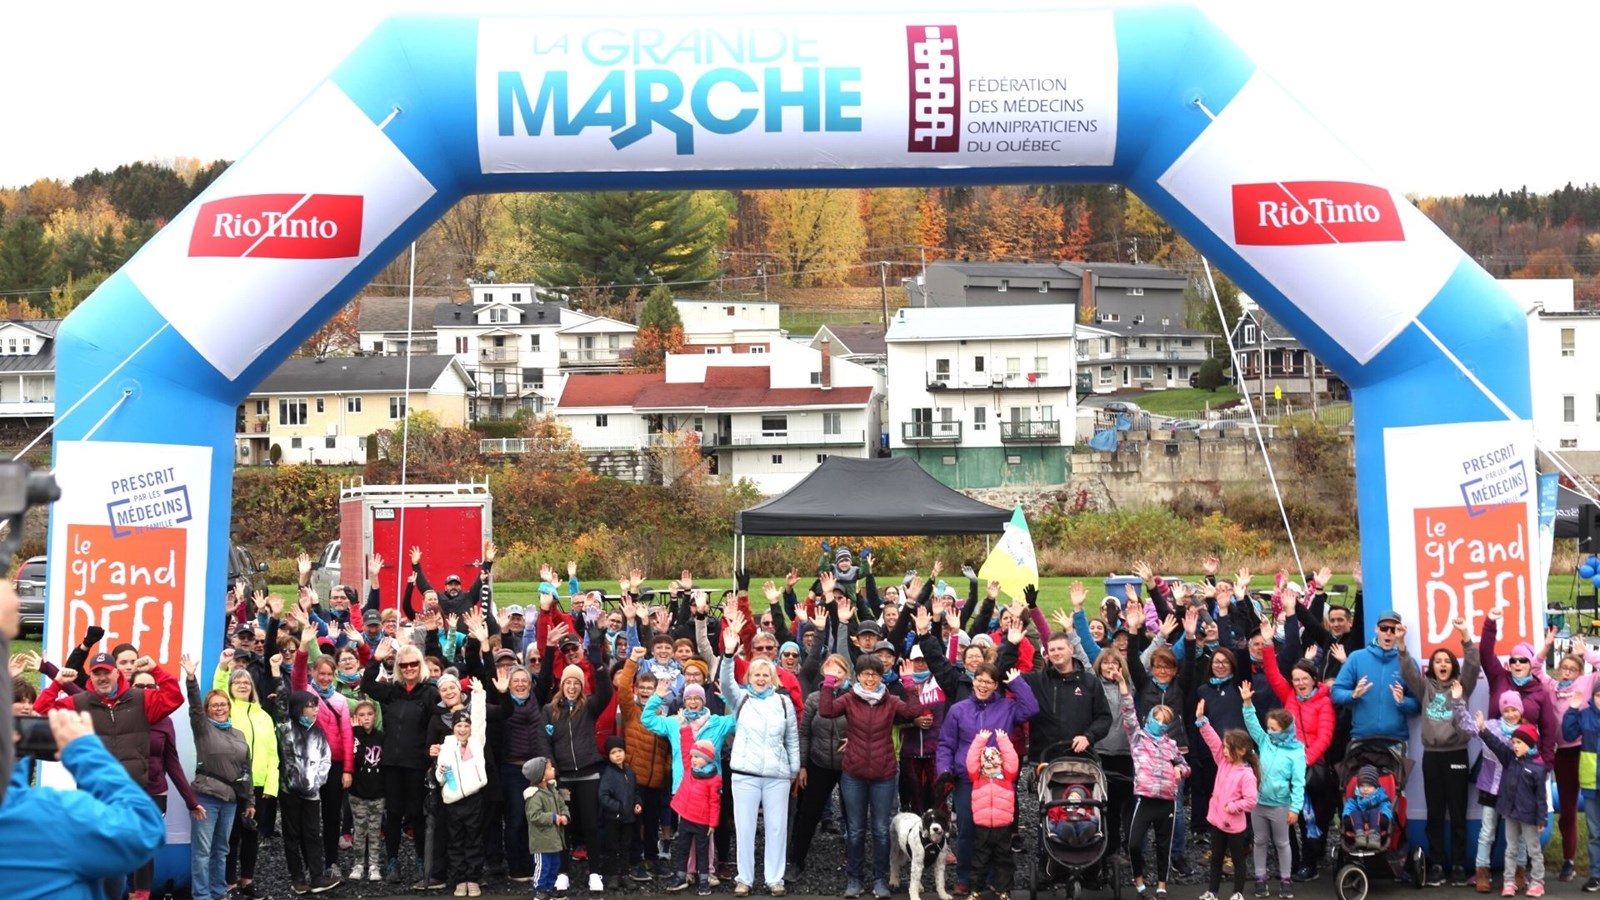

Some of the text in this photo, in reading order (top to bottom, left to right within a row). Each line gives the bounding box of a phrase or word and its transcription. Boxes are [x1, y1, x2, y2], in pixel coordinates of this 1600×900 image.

[533, 26, 819, 66] LA GRANDE
[968, 76, 1067, 92] FÉDÉRATION
[498, 66, 862, 155] MARCHE
[968, 97, 1085, 113] DES MÉDECINS
[967, 119, 1098, 134] OMNIPRATICIENS
[967, 138, 1062, 153] DU QUÉBEC
[1462, 443, 1516, 475] PRESCRIT
[111, 467, 174, 495] PRESCRIT
[1471, 472, 1524, 504] MÉDECINS
[134, 490, 161, 502] PAR LES
[117, 498, 183, 525] MÉDECINS
[1426, 516, 1446, 538] le
[74, 534, 91, 555] le
[1424, 523, 1525, 578] grand
[72, 549, 176, 596] grand
